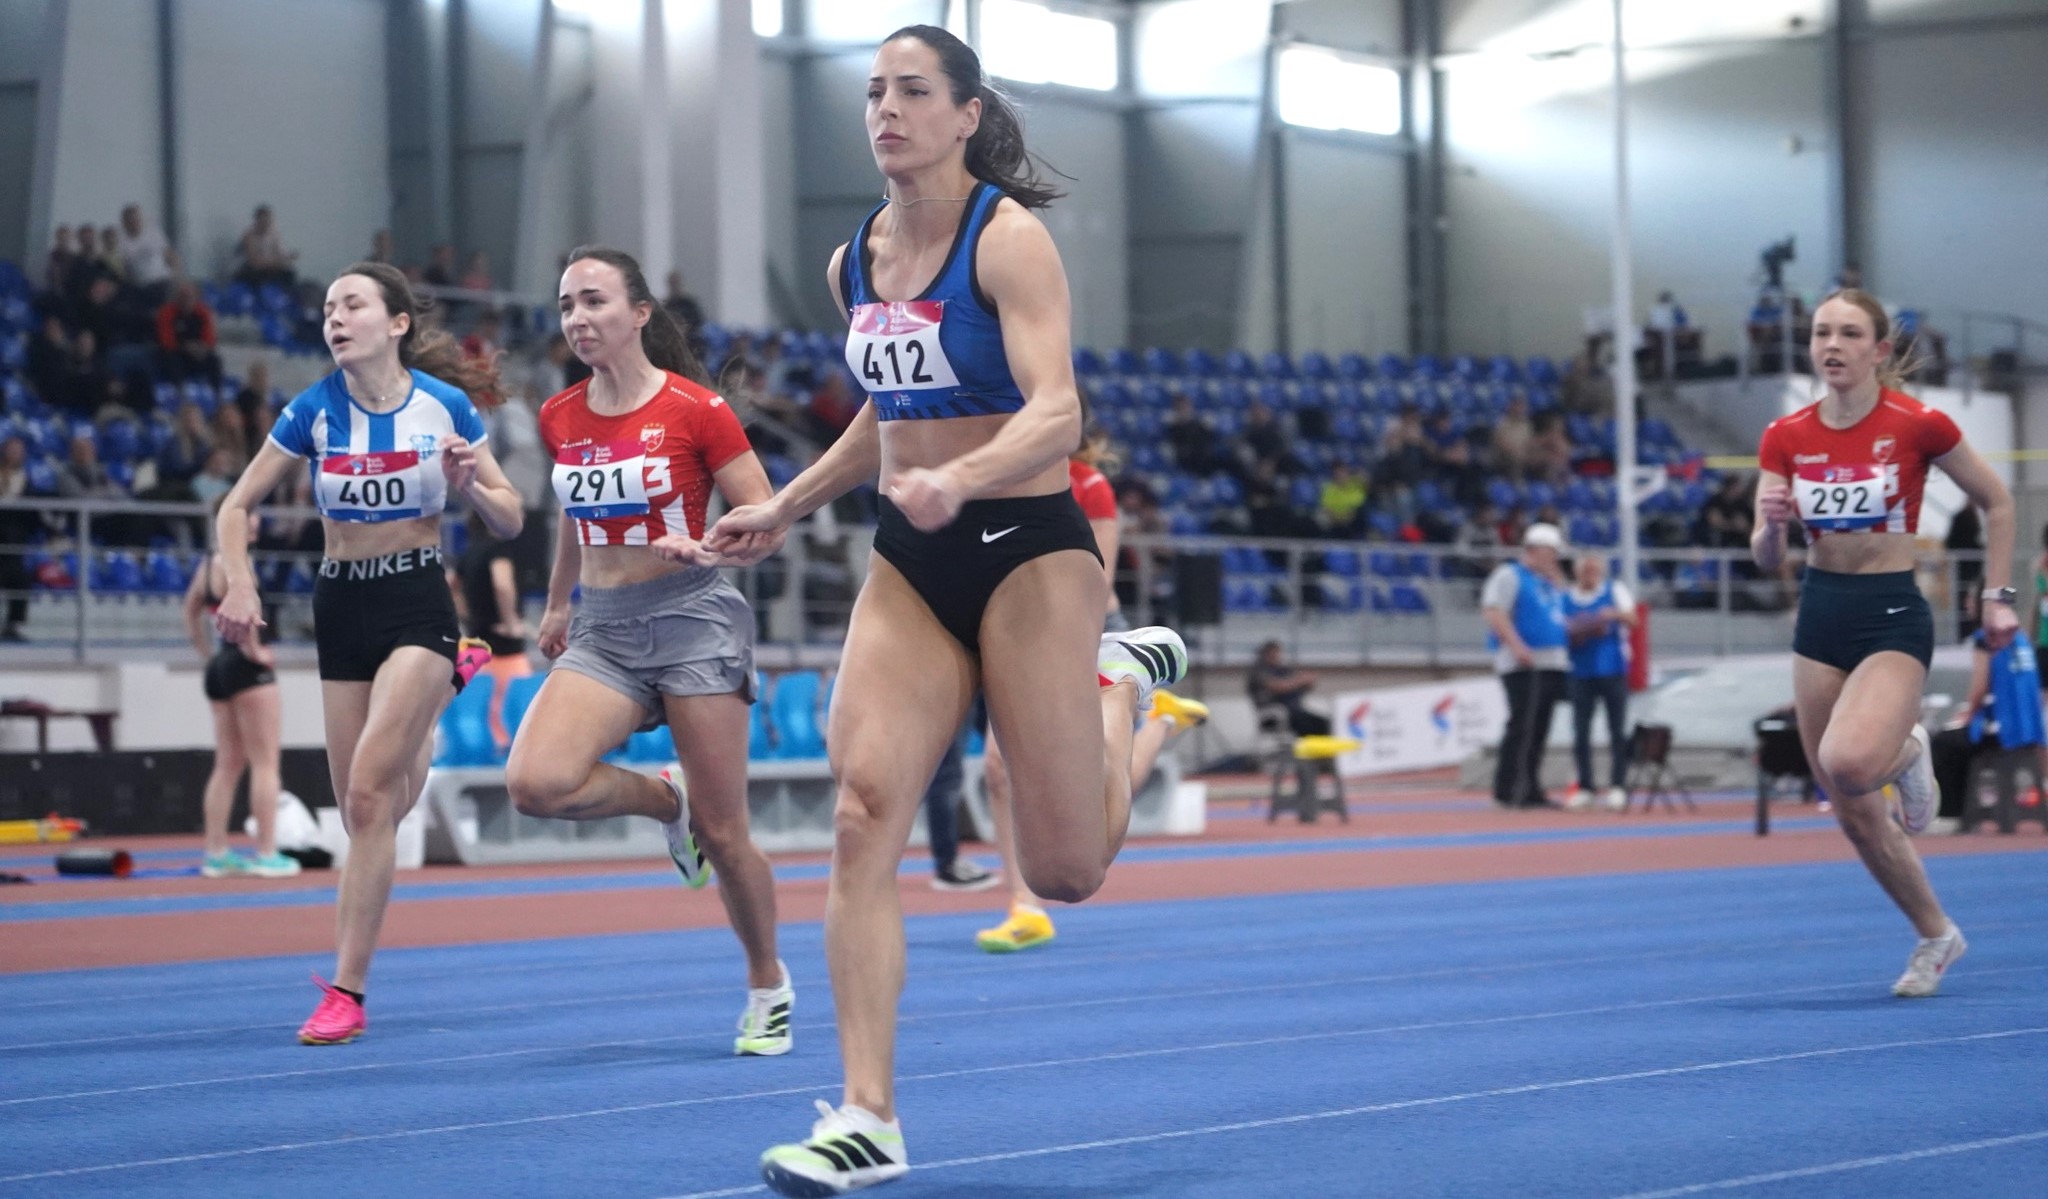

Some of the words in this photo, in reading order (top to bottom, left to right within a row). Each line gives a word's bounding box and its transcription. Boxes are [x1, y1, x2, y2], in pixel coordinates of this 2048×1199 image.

[863, 340, 933, 385] 412
[338, 478, 405, 507] 400
[567, 468, 626, 502] 291
[1811, 486, 1870, 515] 292
[348, 551, 414, 581] NIKE
